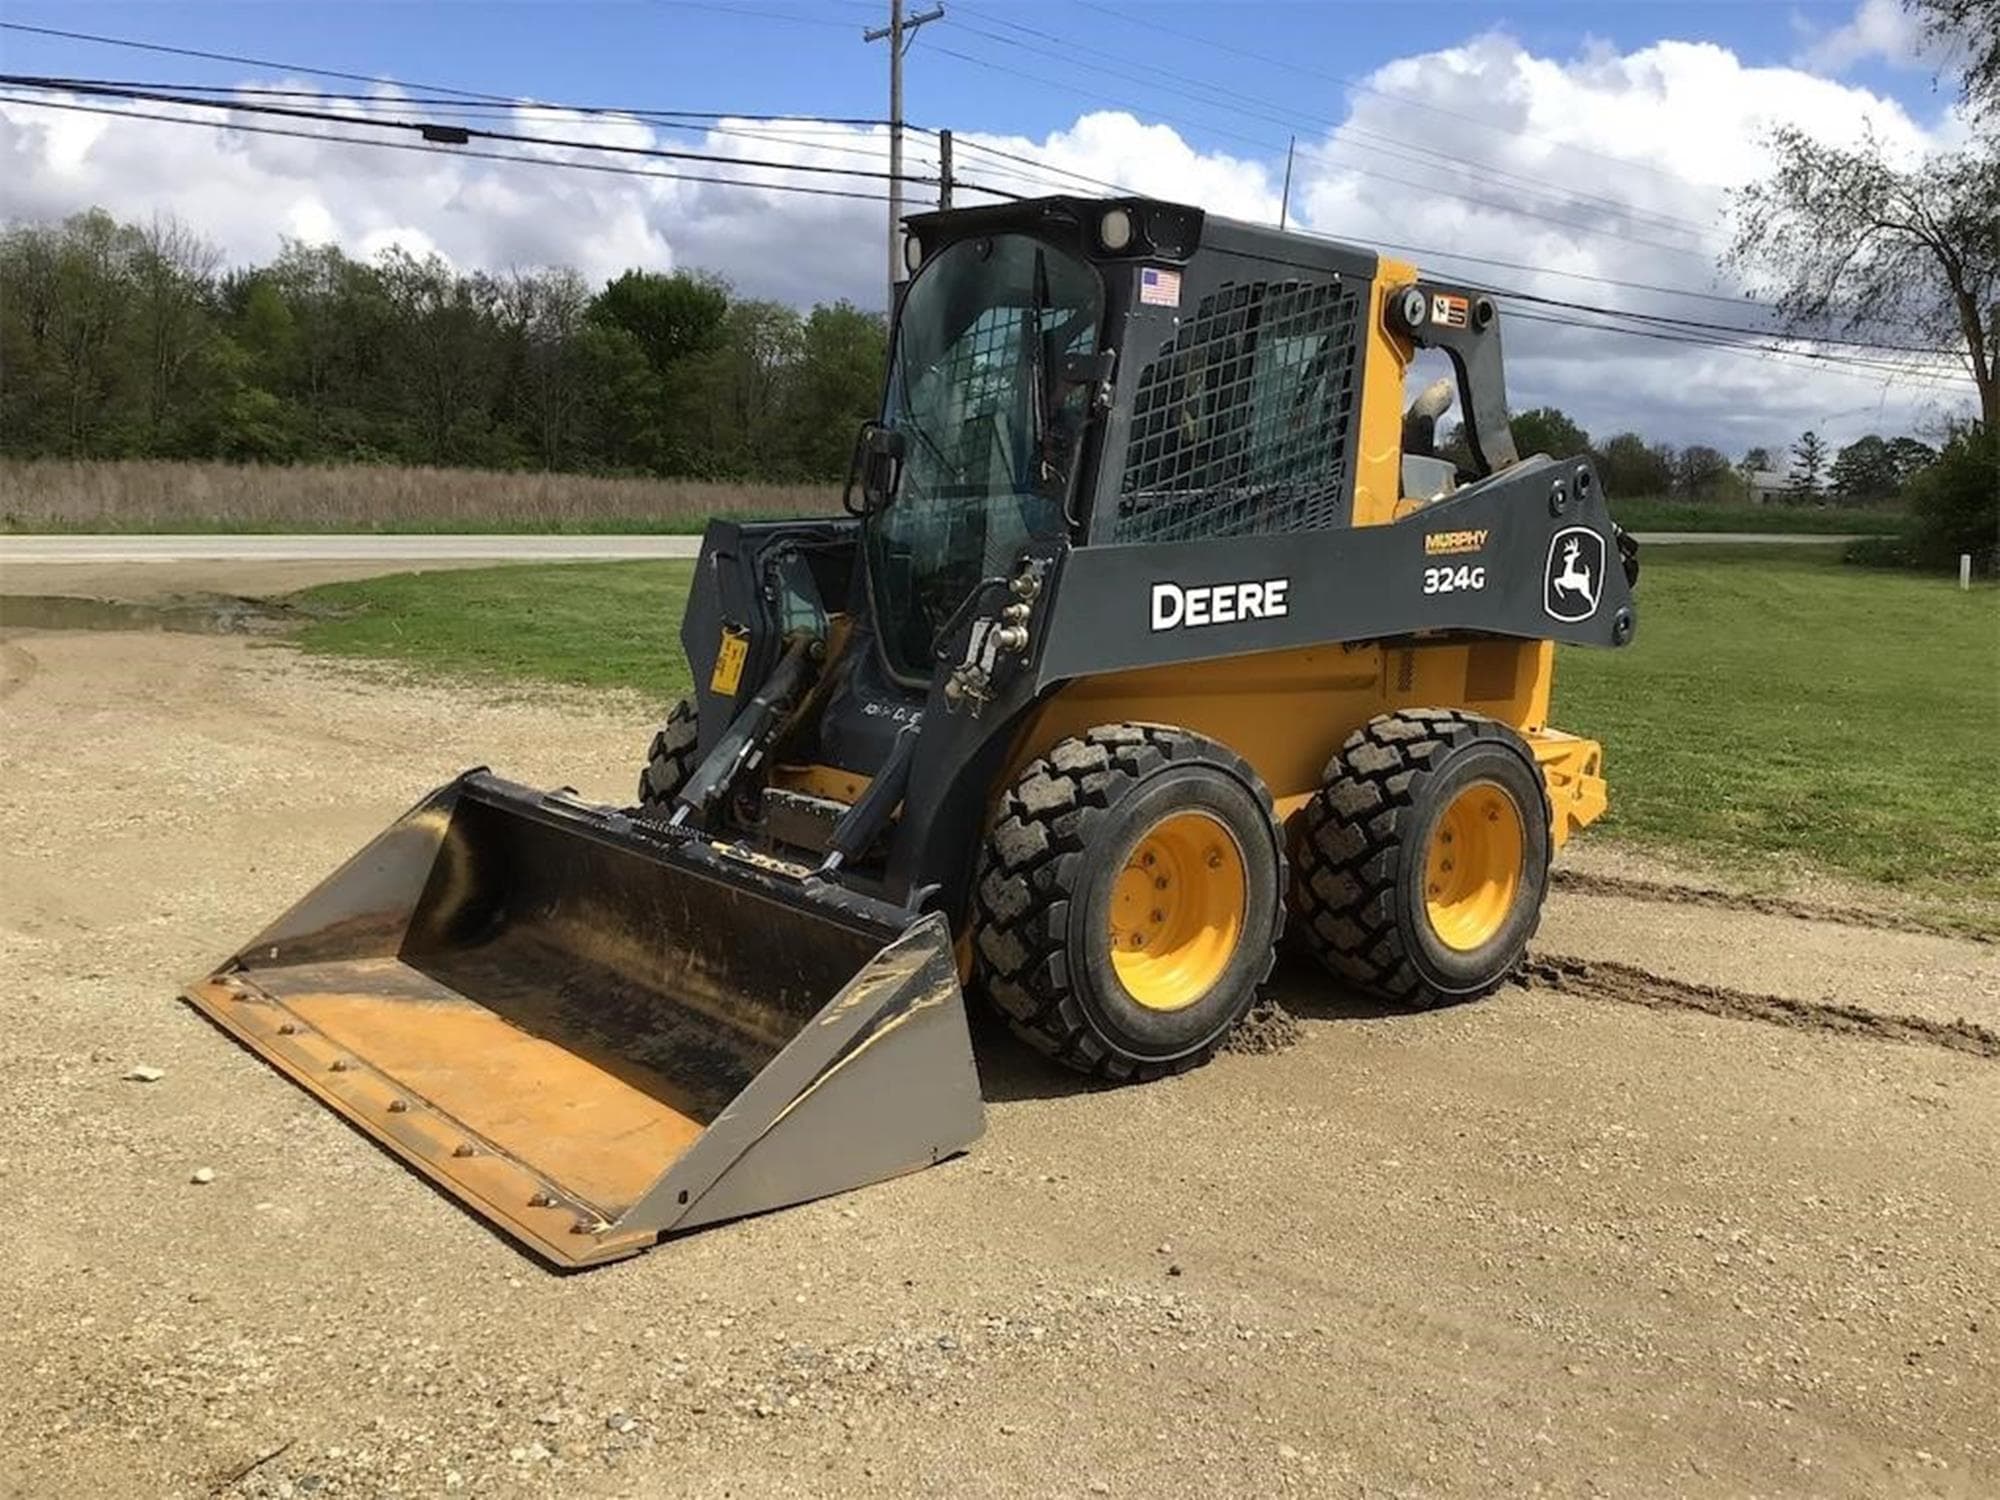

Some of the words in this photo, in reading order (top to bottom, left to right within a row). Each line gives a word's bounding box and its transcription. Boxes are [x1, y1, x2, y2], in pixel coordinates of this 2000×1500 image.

[1425, 530, 1488, 550] MURPHY
[1423, 565, 1486, 594] 324G
[1151, 579, 1289, 631] DEERE
